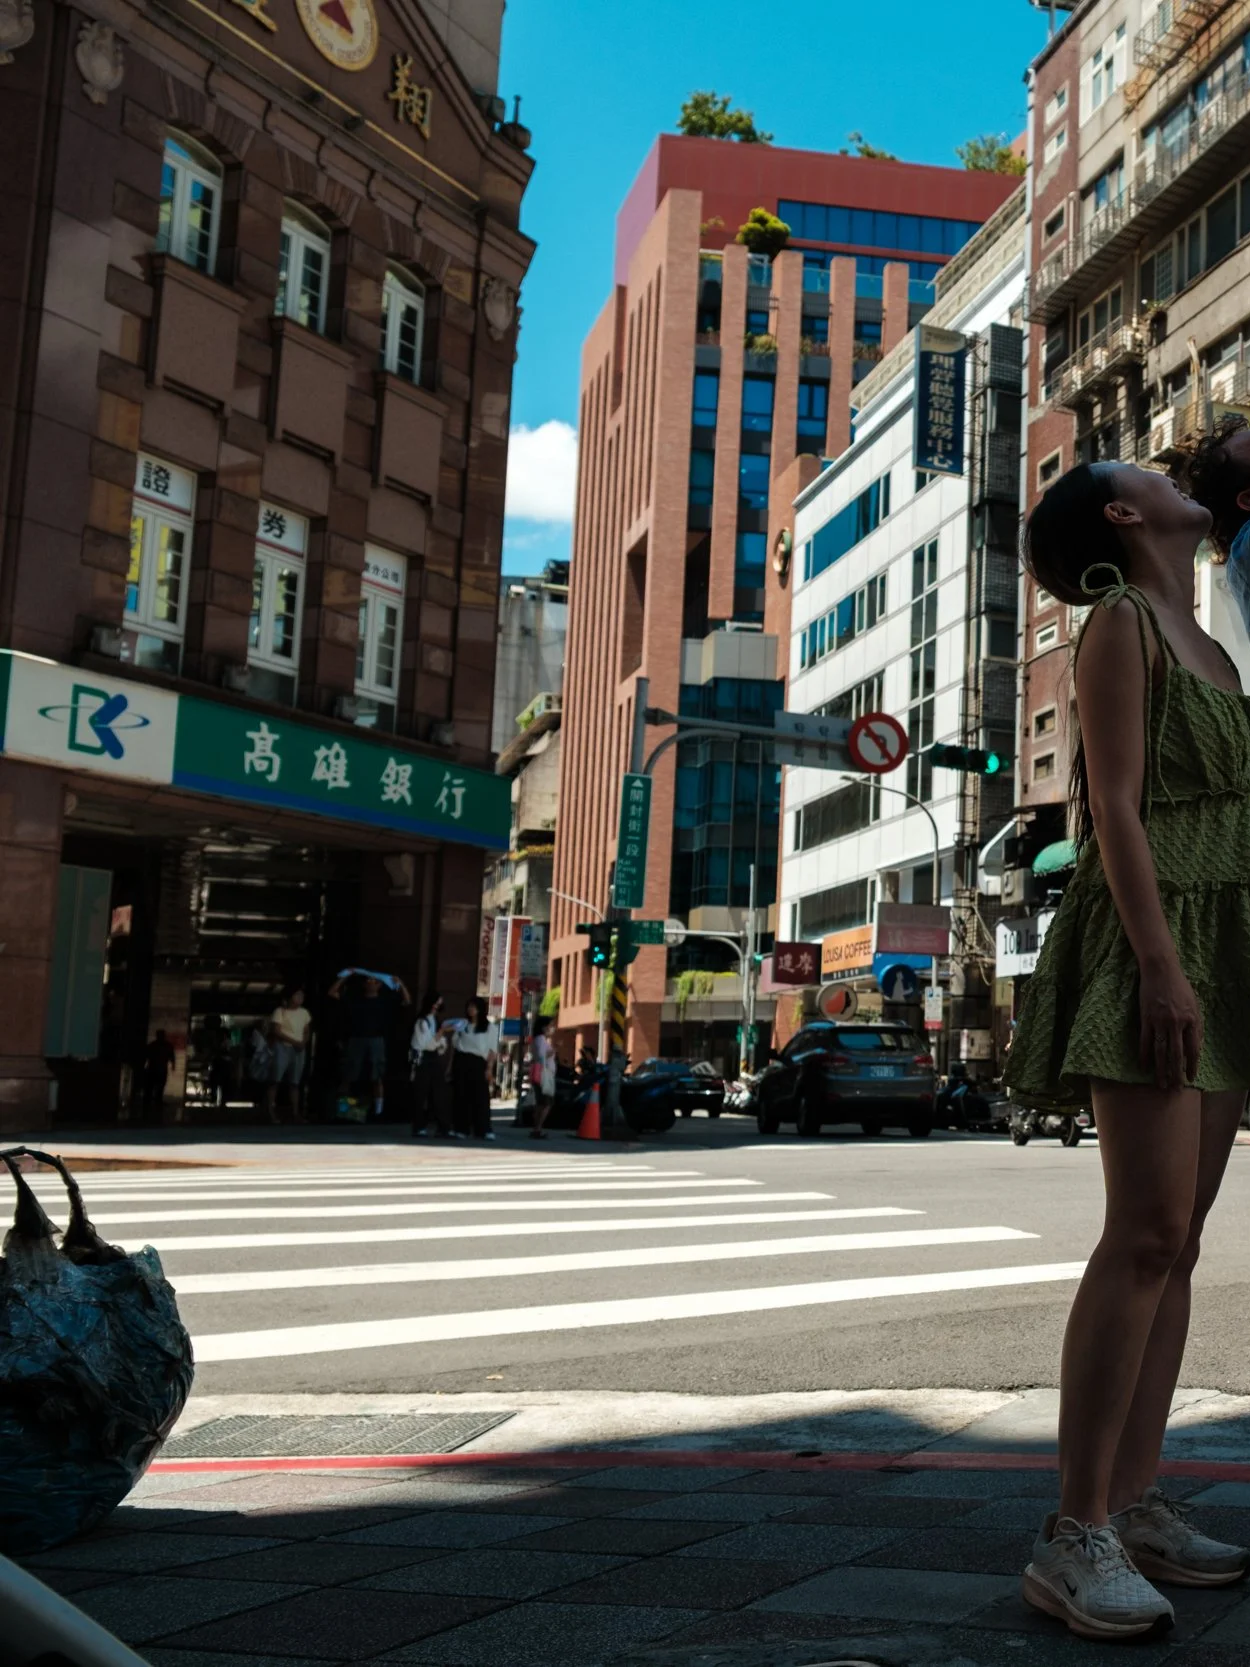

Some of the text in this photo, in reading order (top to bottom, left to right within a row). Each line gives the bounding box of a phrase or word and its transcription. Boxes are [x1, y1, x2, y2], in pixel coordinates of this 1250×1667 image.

[386, 52, 433, 140] 翔
[143, 460, 172, 497] 證
[262, 508, 287, 540] 券
[243, 720, 467, 821] 高雄銀行
[478, 914, 494, 985] Pioneer
[845, 939, 871, 960] COFFEE
[1003, 929, 1022, 955] 109
